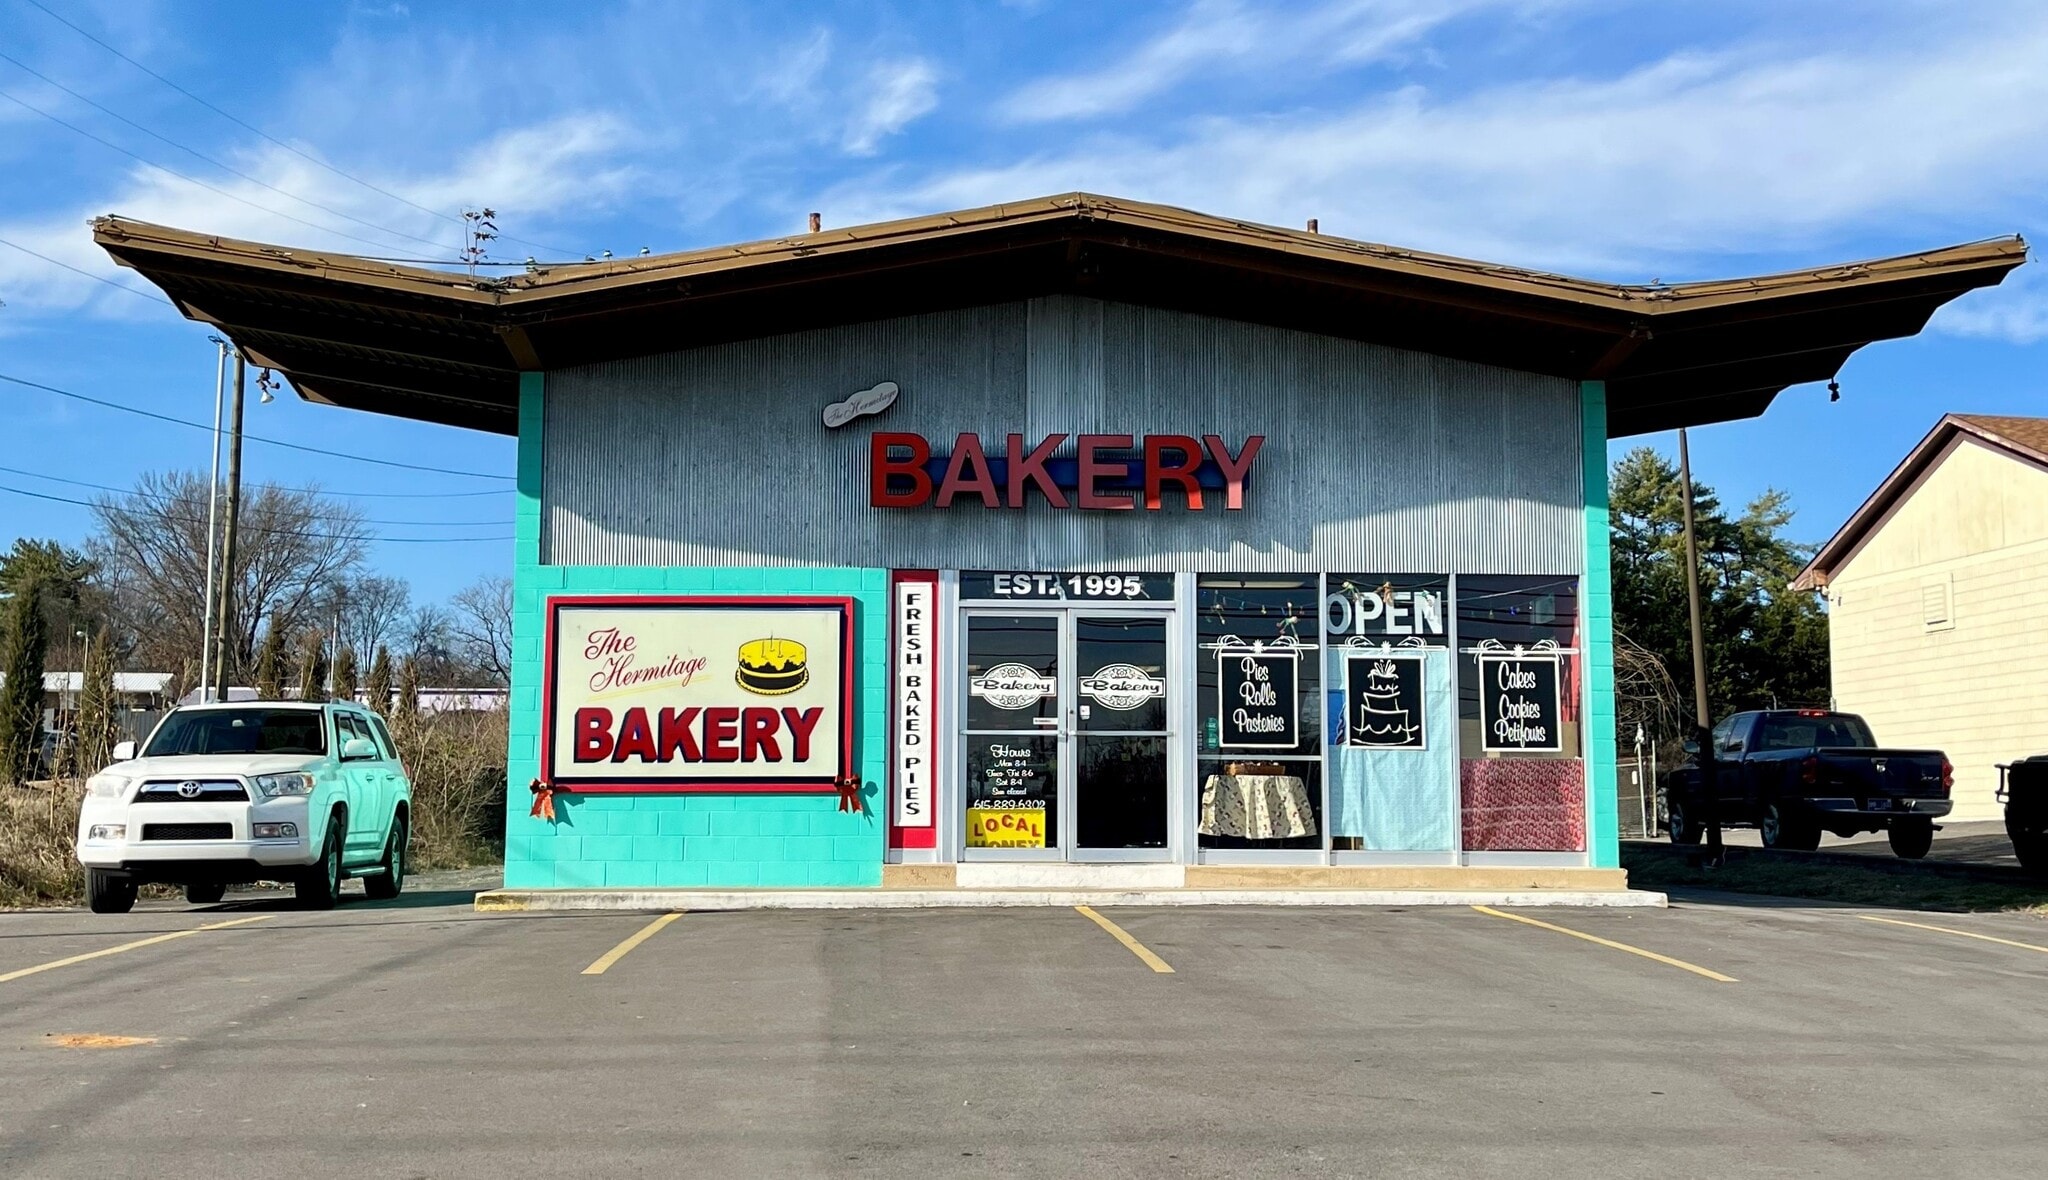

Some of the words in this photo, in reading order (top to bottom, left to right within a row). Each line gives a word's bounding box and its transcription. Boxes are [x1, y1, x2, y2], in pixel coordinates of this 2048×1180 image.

[827, 408, 843, 424] The
[844, 389, 897, 419] Hermitage
[871, 432, 1265, 510] BAKERY
[993, 574, 1057, 596] EST.
[1068, 575, 1142, 596] 1995
[1326, 591, 1443, 635] OPEN
[585, 626, 638, 661] The
[906, 593, 922, 665] FRESH
[589, 653, 708, 693] Hermitage
[1241, 656, 1269, 681] Pies
[1498, 661, 1536, 691] Cakes
[973, 679, 1051, 694] Bakery
[1083, 680, 1160, 695] Bakery
[1239, 681, 1277, 706] Rolls
[905, 675, 921, 746] BAKED
[1233, 708, 1285, 733] Pasteries
[1499, 693, 1541, 721] Cookies
[573, 707, 824, 763] BAKERY
[1494, 718, 1546, 748] Petifours
[990, 744, 1031, 758] Hours
[905, 757, 921, 815] PIES
[974, 799, 1045, 810] 615-889-6302
[974, 814, 1041, 837] LOCAL
